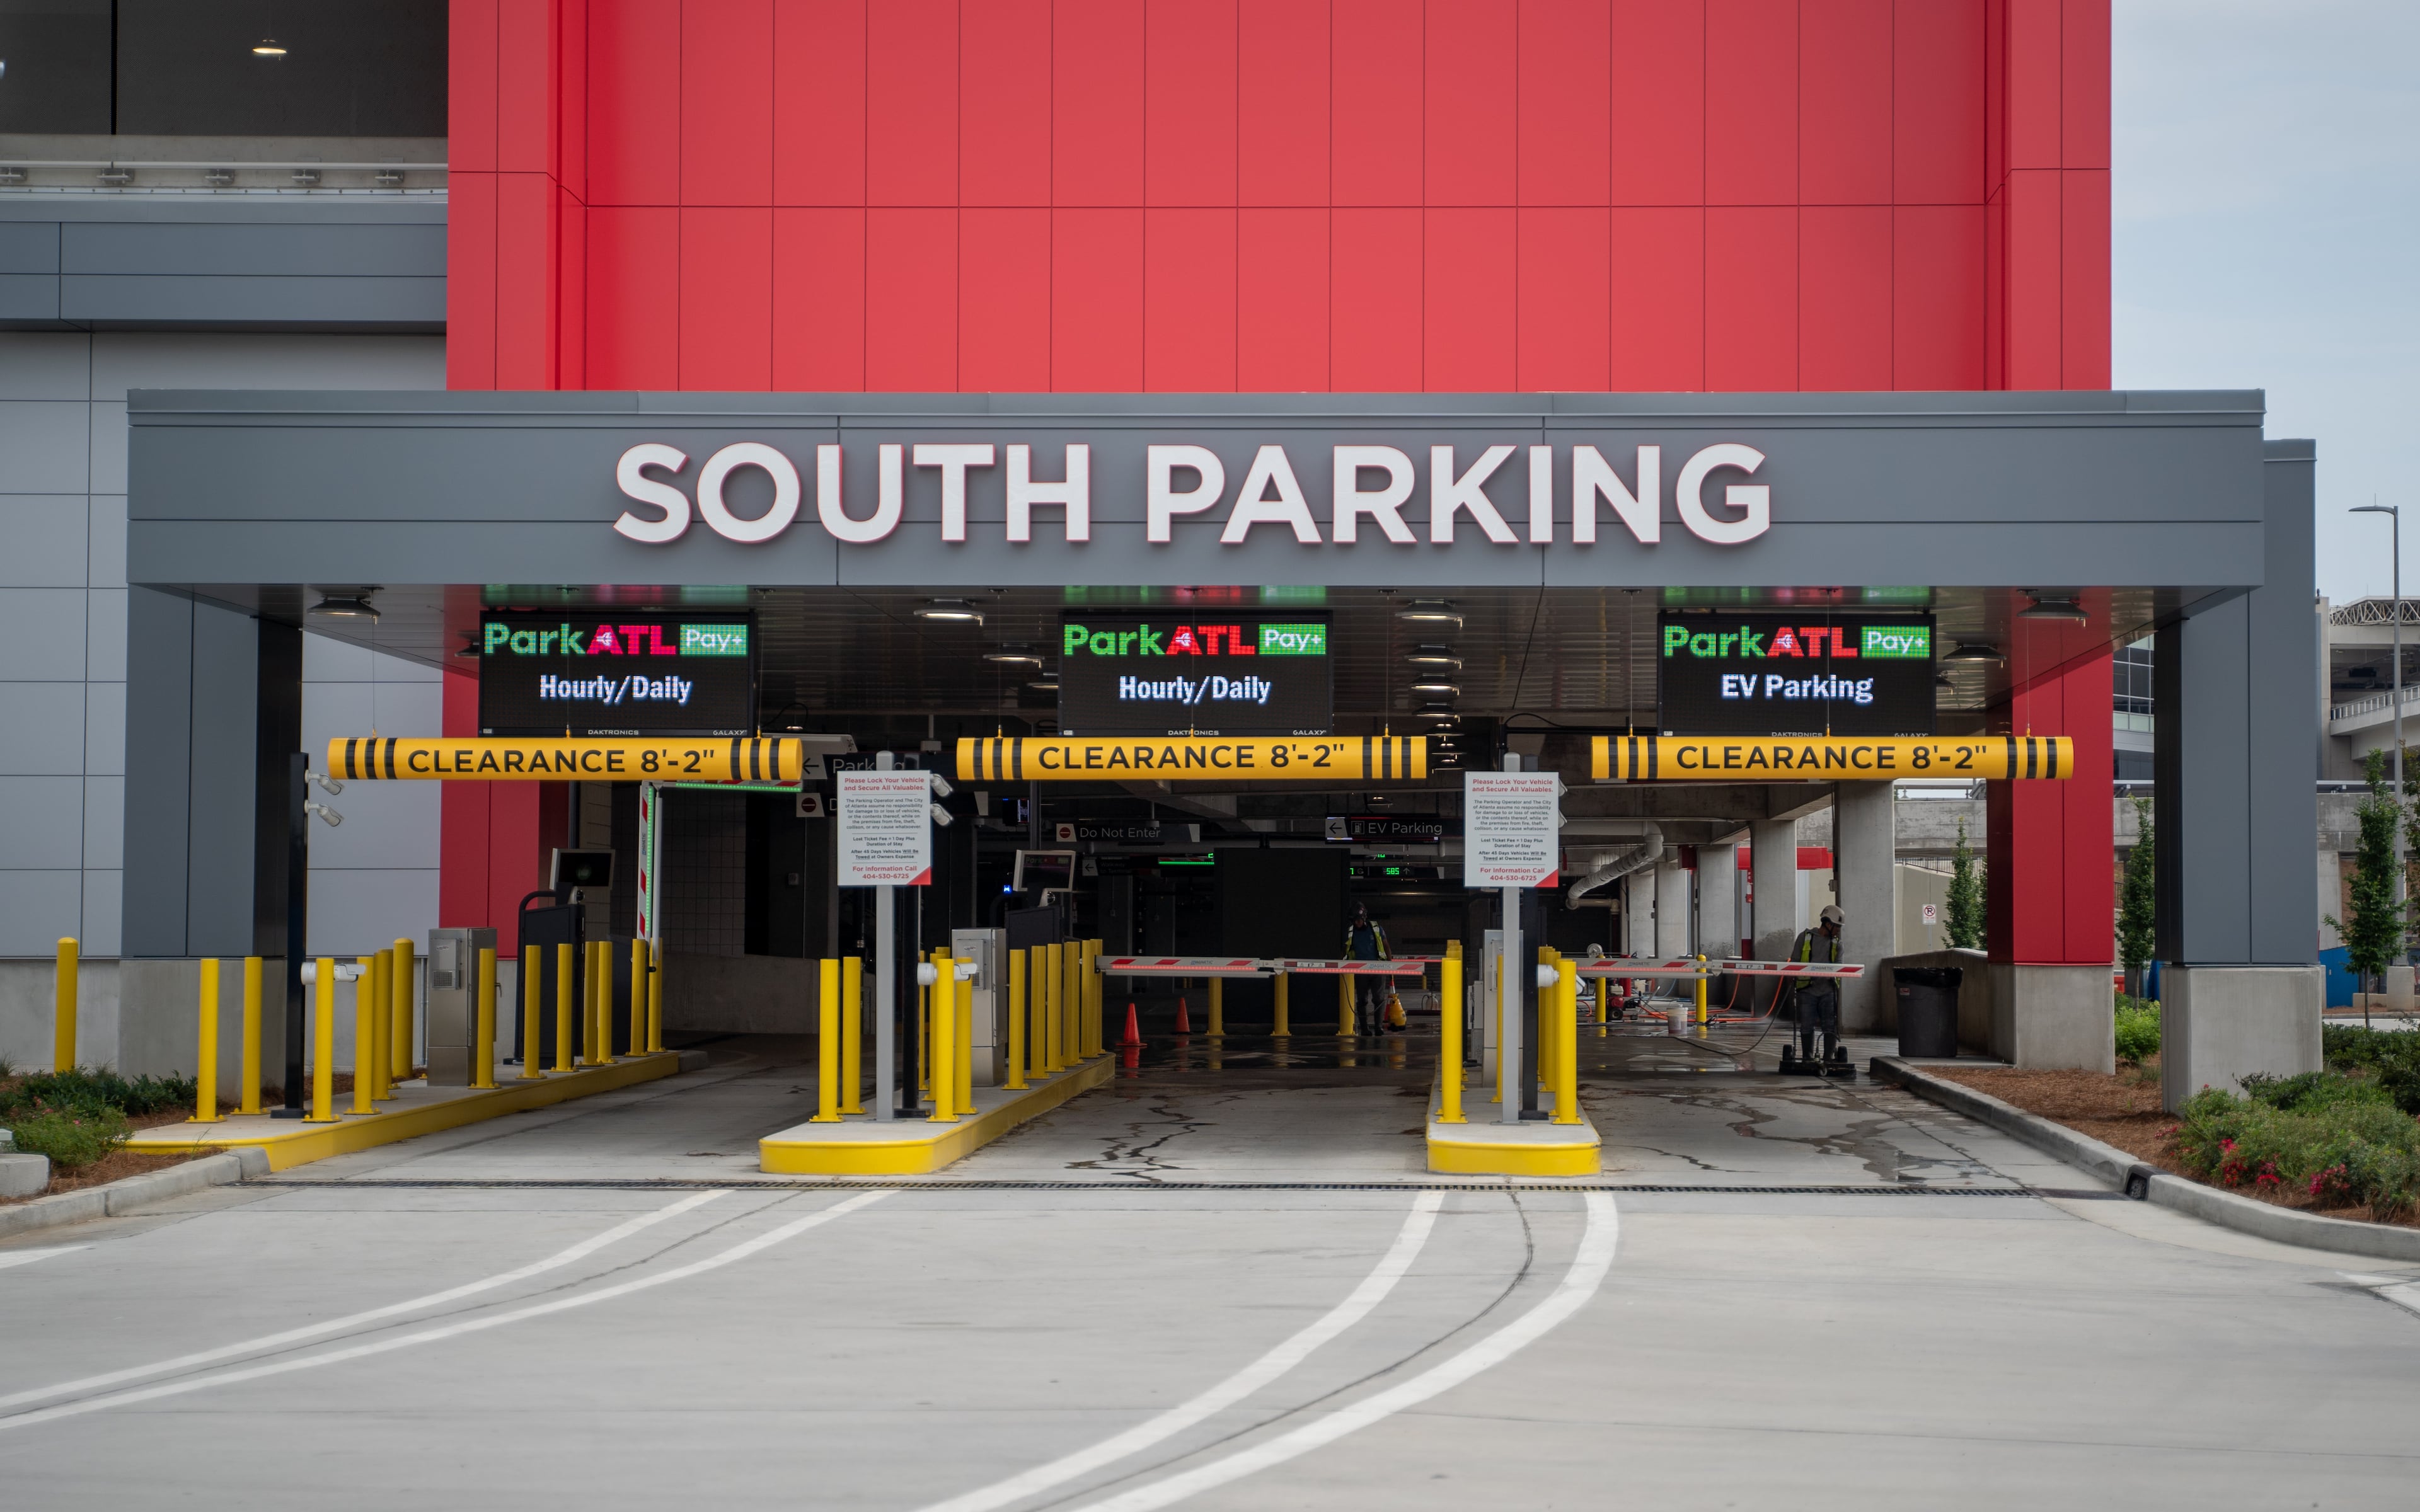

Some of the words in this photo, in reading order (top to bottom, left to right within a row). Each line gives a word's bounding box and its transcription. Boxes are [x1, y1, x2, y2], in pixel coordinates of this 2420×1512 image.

[613, 442, 1090, 544] SOUTH
[1147, 442, 1770, 544] PARKING
[687, 628, 742, 652] Pay+
[1264, 629, 1322, 651] Pay+
[1866, 631, 1926, 653] Pay+
[539, 675, 691, 704] Hourly/Daily
[1119, 675, 1270, 704] Hourly/Daily
[1721, 674, 1758, 697] EV
[1765, 674, 1874, 704] Parking
[407, 749, 625, 773] CLEARANCE
[640, 748, 715, 773] 8'-2"
[1038, 745, 1255, 769] CLEARANCE
[1270, 743, 1345, 768] 8'-2"
[1677, 745, 1896, 769] CLEARANCE
[1912, 745, 1987, 769] 8'-2"
[1080, 827, 1097, 838] Do
[1102, 827, 1123, 838] Not
[1128, 827, 1161, 838] Enter
[1368, 823, 1386, 833] EV
[1392, 822, 1443, 835] Parking
